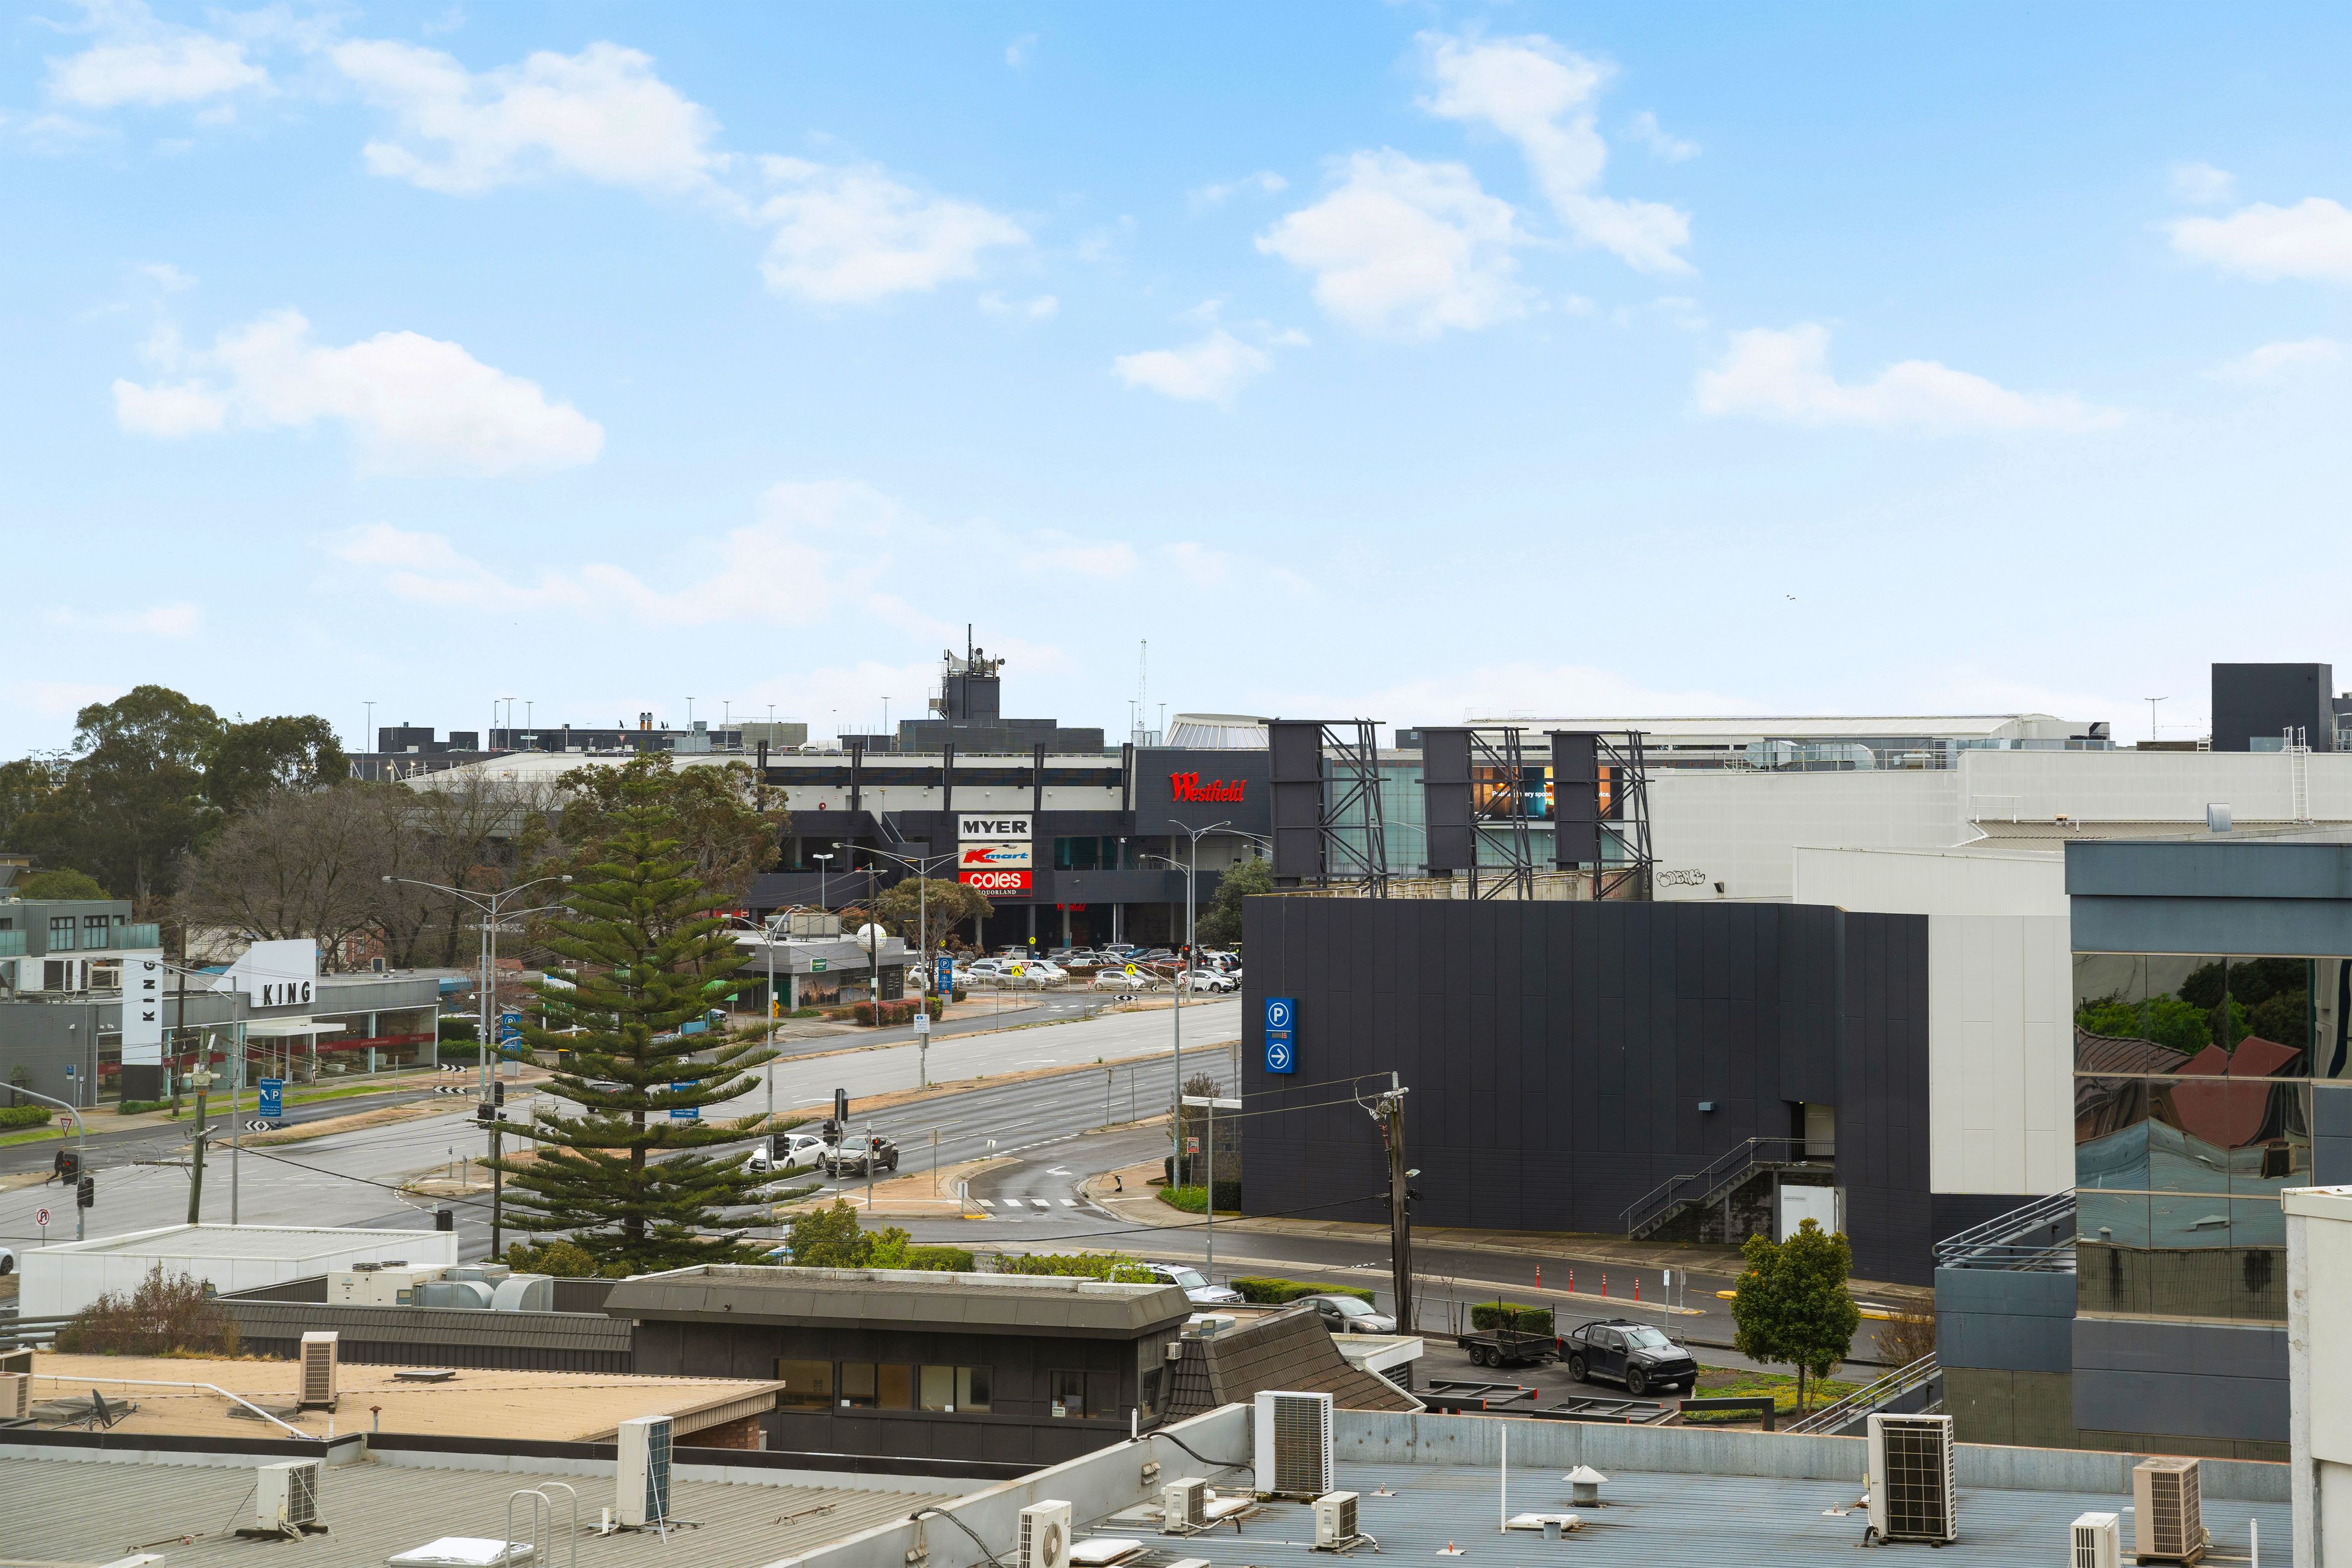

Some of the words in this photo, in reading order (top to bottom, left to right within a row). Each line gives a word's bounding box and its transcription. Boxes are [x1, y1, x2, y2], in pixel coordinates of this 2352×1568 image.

[1169, 772, 1247, 802] Westfield
[963, 821, 1027, 833] MYER
[963, 848, 1028, 863] Kmart
[970, 872, 1021, 888] coles
[143, 960, 156, 1021] KING
[263, 981, 310, 1006] KING
[1274, 1008, 1284, 1022] P
